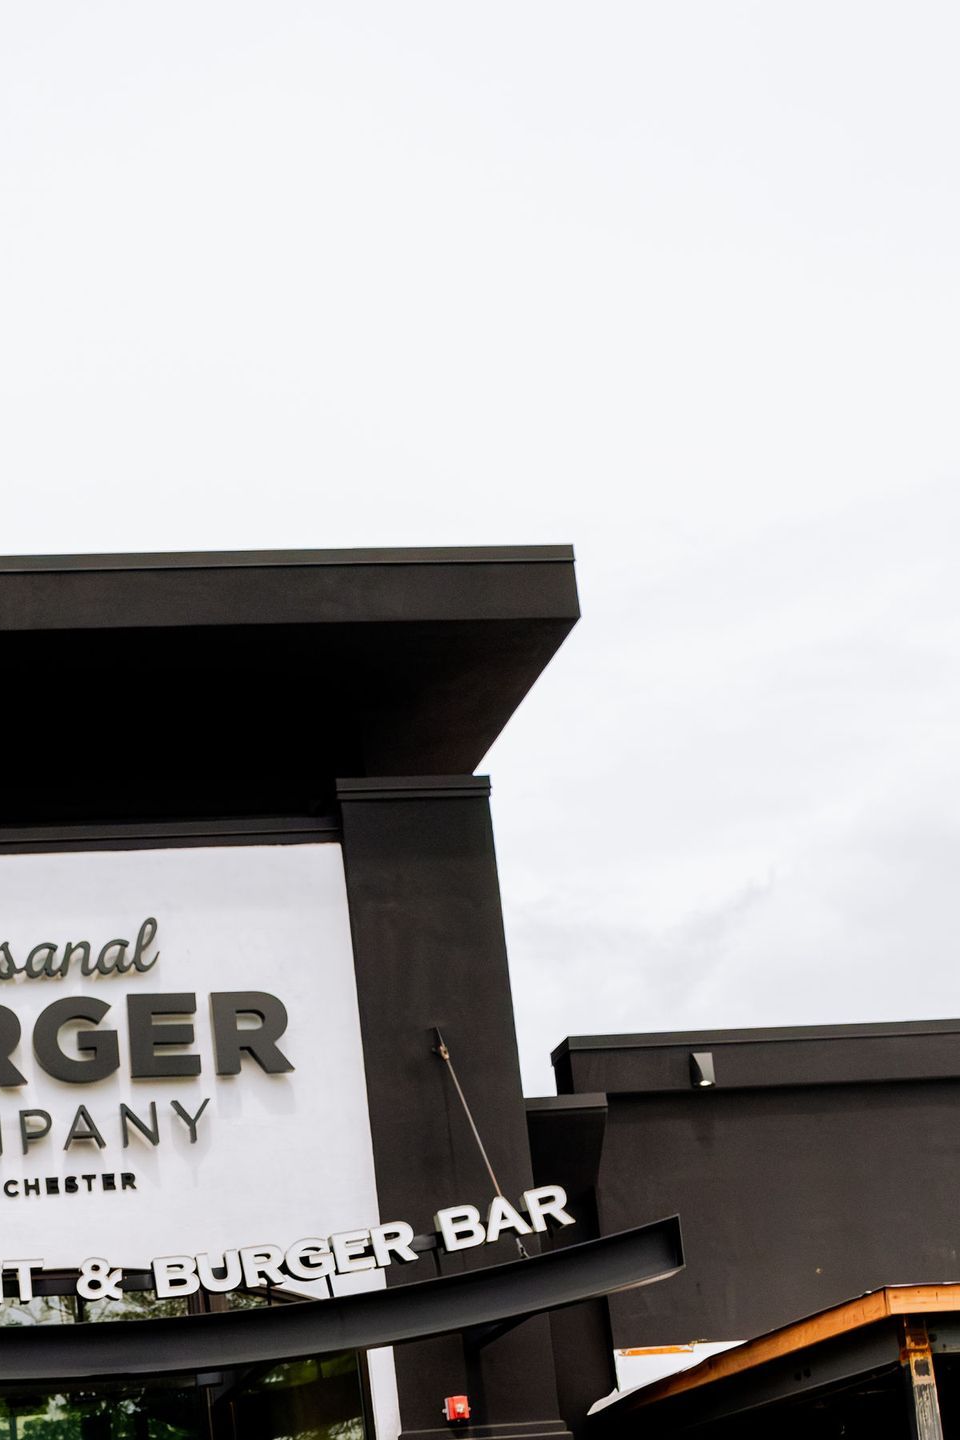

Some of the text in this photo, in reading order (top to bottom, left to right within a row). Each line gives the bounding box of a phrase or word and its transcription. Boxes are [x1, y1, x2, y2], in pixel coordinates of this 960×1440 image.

[76, 1256, 123, 1299] &
[151, 1220, 418, 1299] BURGER
[435, 1184, 576, 1252] BAR
